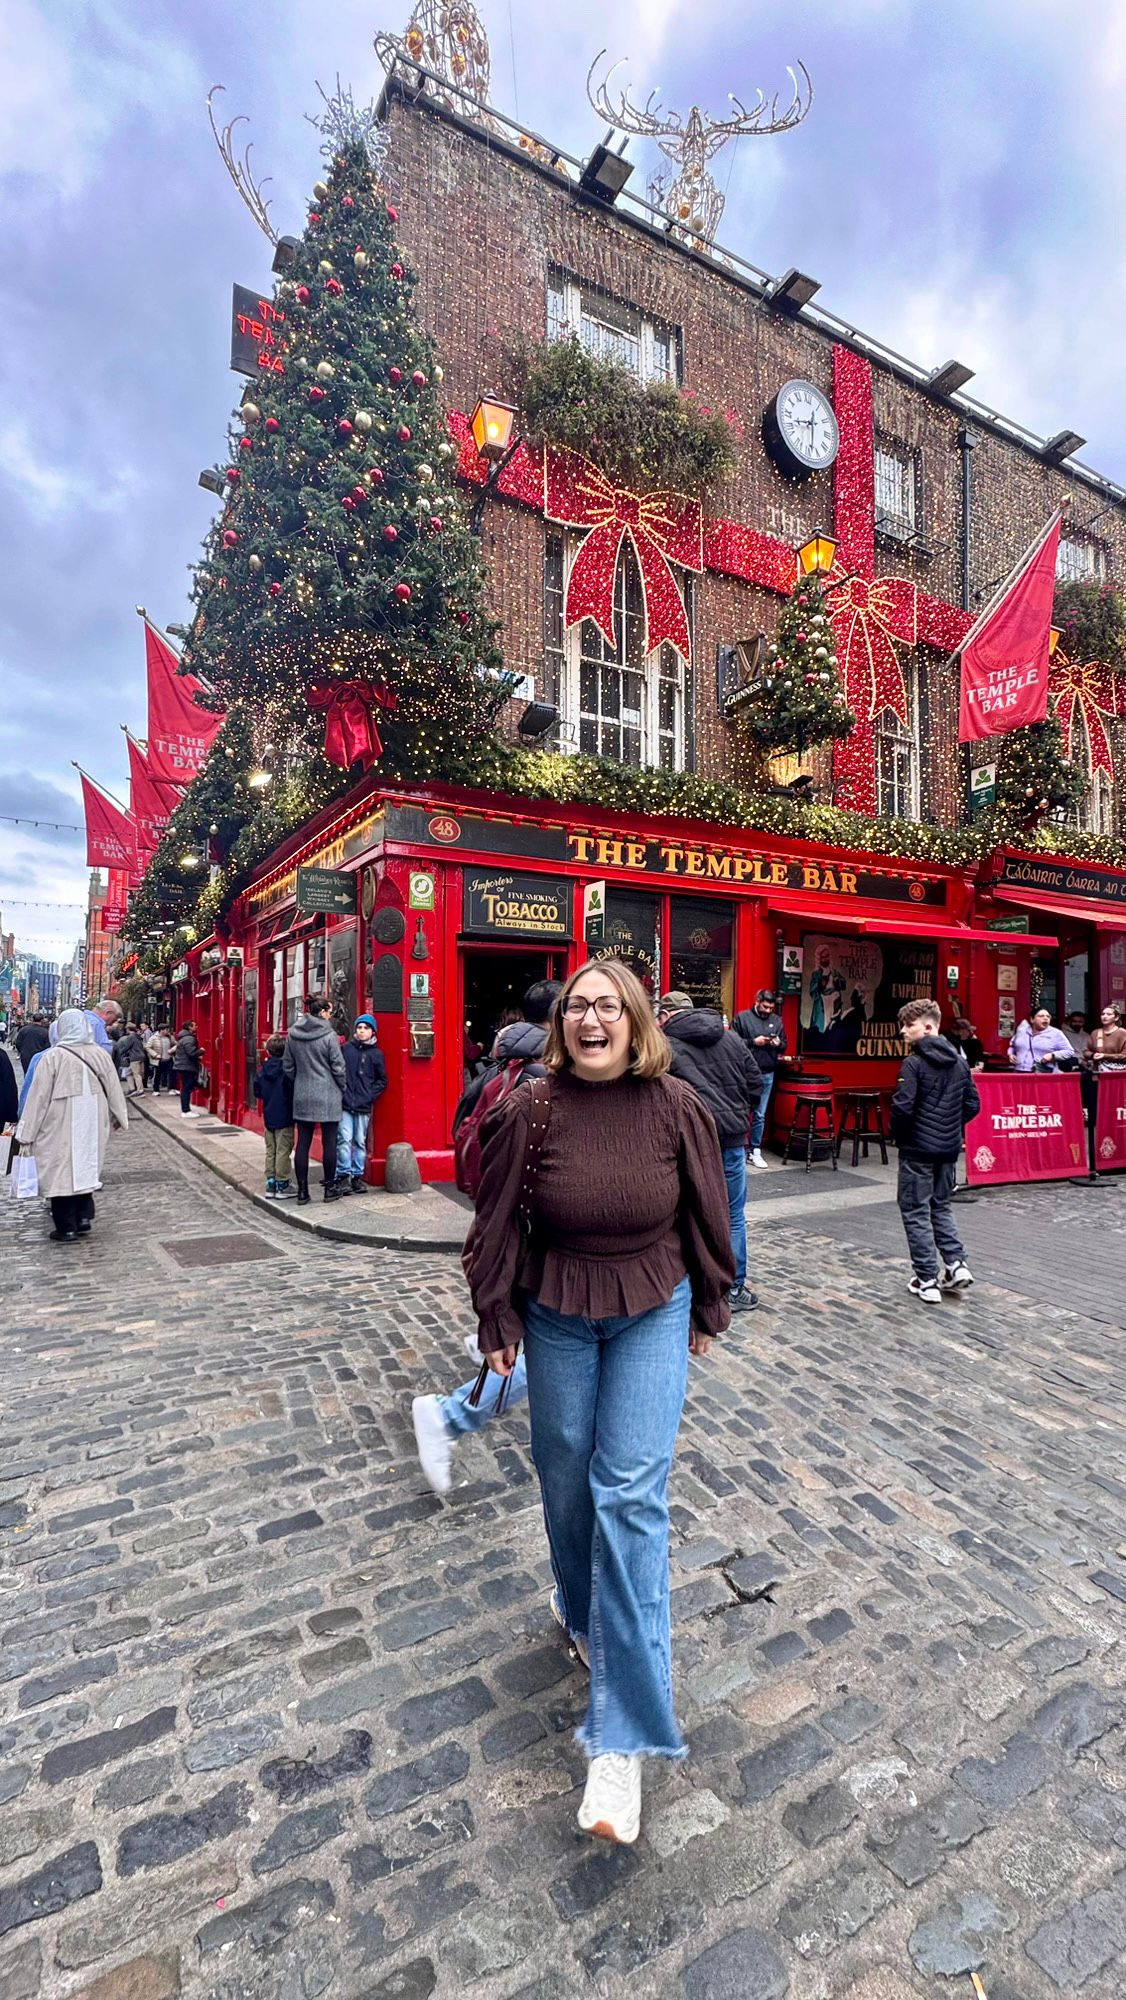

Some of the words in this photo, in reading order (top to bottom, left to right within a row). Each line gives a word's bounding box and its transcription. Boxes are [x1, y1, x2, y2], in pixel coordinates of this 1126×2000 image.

[258, 300, 285, 321] TH
[258, 350, 285, 373] BA
[987, 665, 1018, 684] THE
[966, 668, 1039, 704] TEMPLE
[982, 693, 1019, 715] BAR
[176, 734, 206, 747] THE
[155, 739, 206, 760] TEMP
[434, 820, 454, 837] 48
[92, 841, 133, 855] TEMPE
[568, 834, 647, 868] THE
[661, 847, 788, 885] TEMPLE
[802, 867, 858, 894] BAR
[468, 876, 514, 894] Importers
[507, 891, 524, 901] FINE
[525, 893, 558, 903] SMOKING
[480, 893, 558, 924] TOBACCO
[496, 919, 527, 928] Always
[530, 921, 538, 929] in
[541, 921, 564, 931] Stock
[618, 931, 633, 940] THE
[839, 955, 878, 970] TEMPLE
[848, 967, 868, 981] BAR
[914, 969, 932, 985] THE
[891, 983, 932, 999] EMPEROR
[861, 1020, 896, 1038] MALTED
[856, 1038, 913, 1057] GUINNE
[1016, 1103, 1037, 1115] THE
[991, 1114, 1038, 1129] TEMPLE
[1037, 1113, 1063, 1128] BAR
